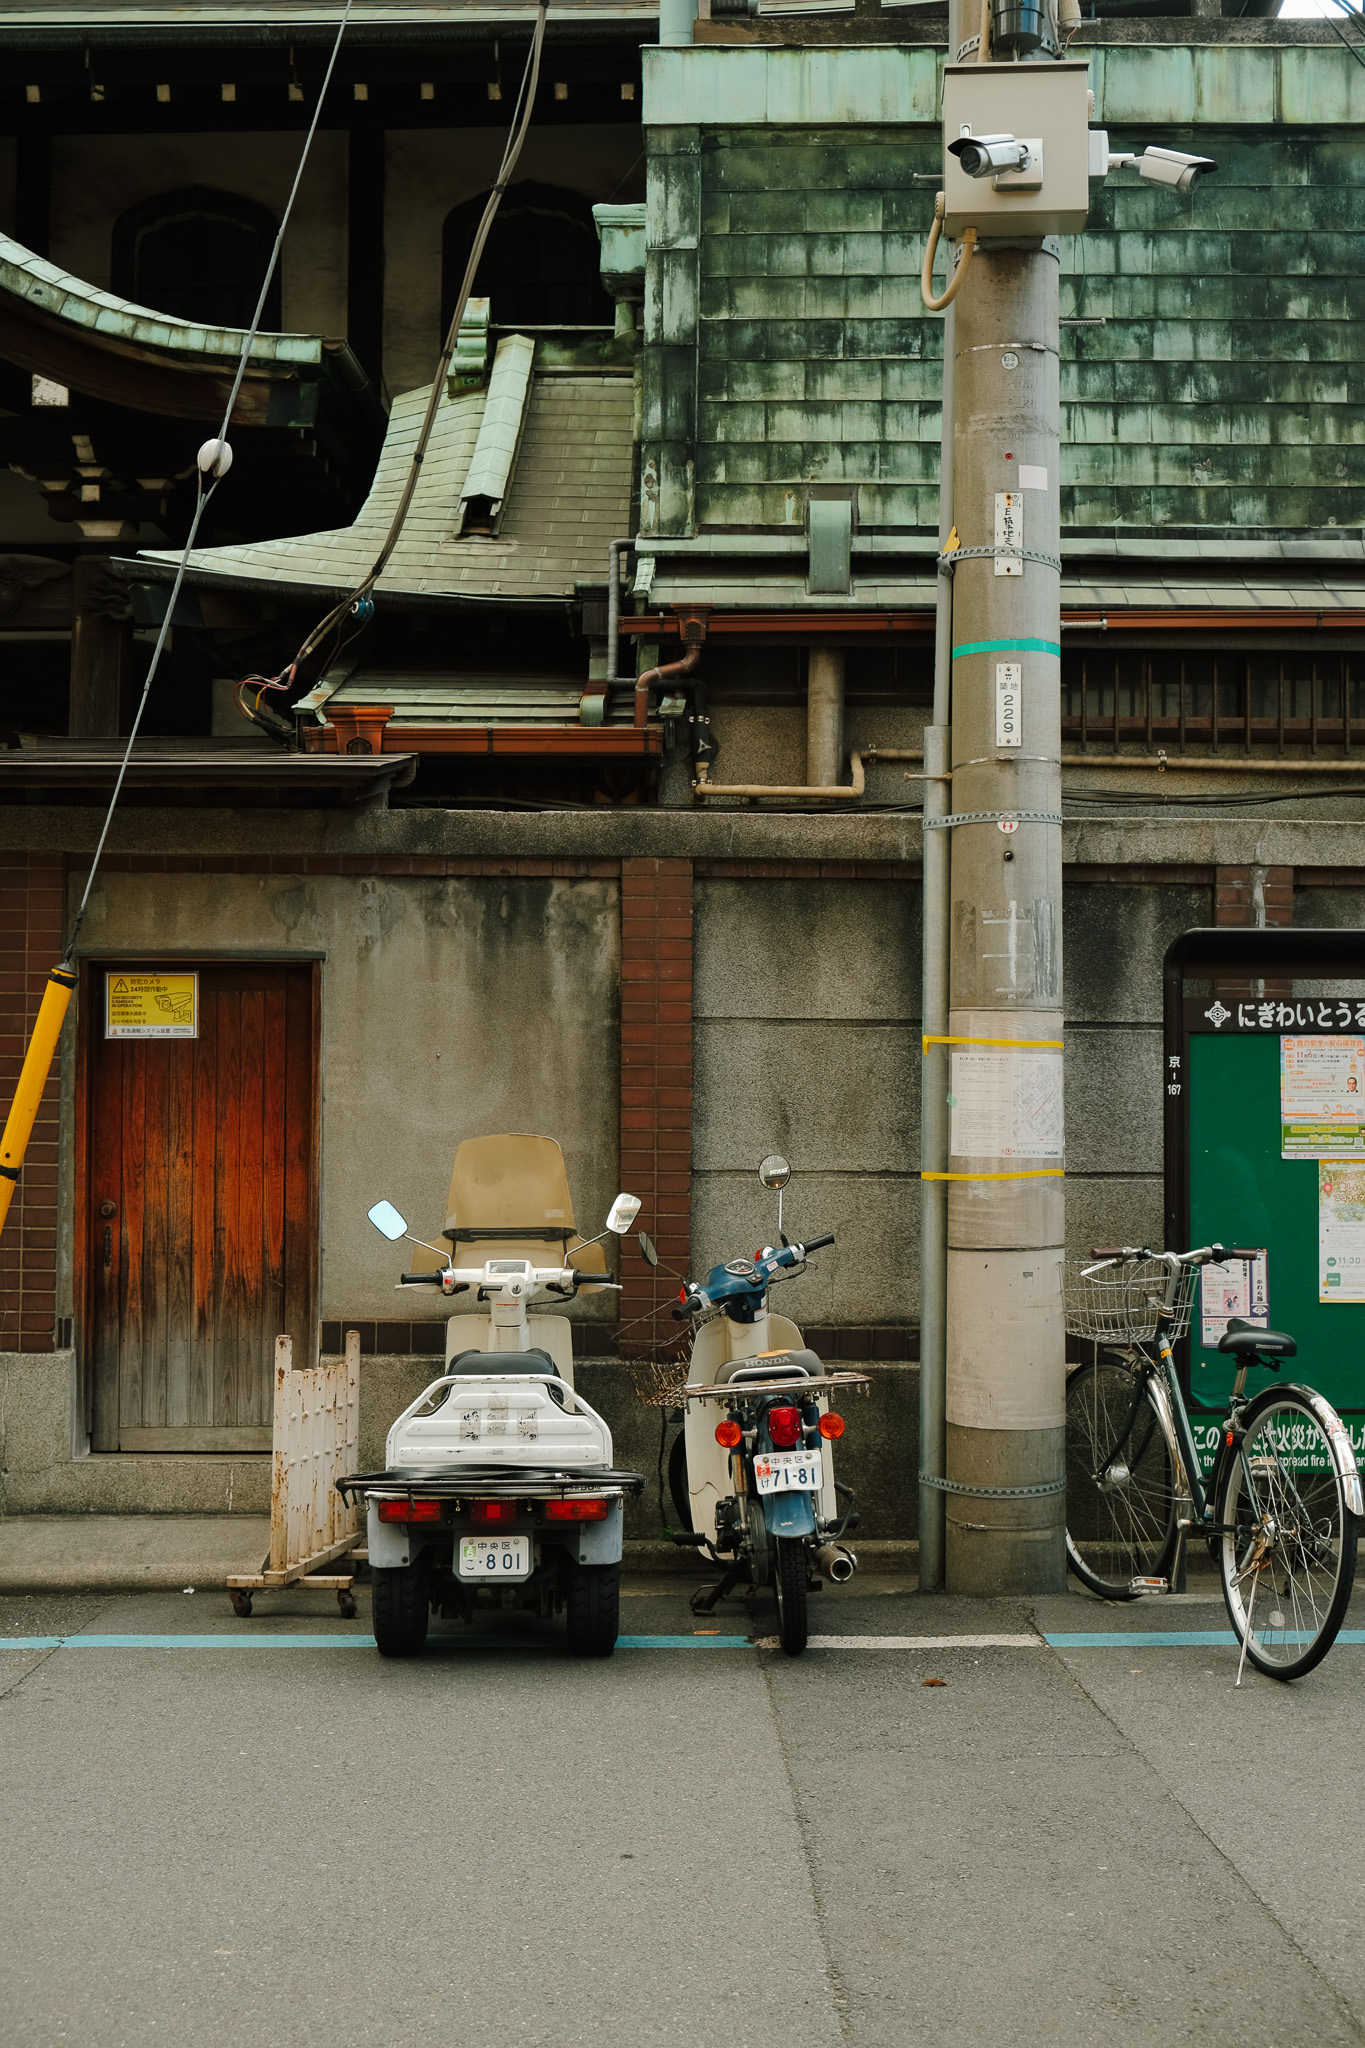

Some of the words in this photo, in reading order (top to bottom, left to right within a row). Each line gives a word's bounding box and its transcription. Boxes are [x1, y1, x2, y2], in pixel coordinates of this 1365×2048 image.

[1000, 682, 1018, 691] 築地
[1004, 694, 1014, 733] 229
[744, 1356, 791, 1368] HONDA
[771, 1456, 804, 1465] 中央区
[1311, 1455, 1325, 1466] fire
[761, 1478, 769, 1488] け
[773, 1468, 815, 1487] 71-81
[478, 1542, 510, 1550] 中央区
